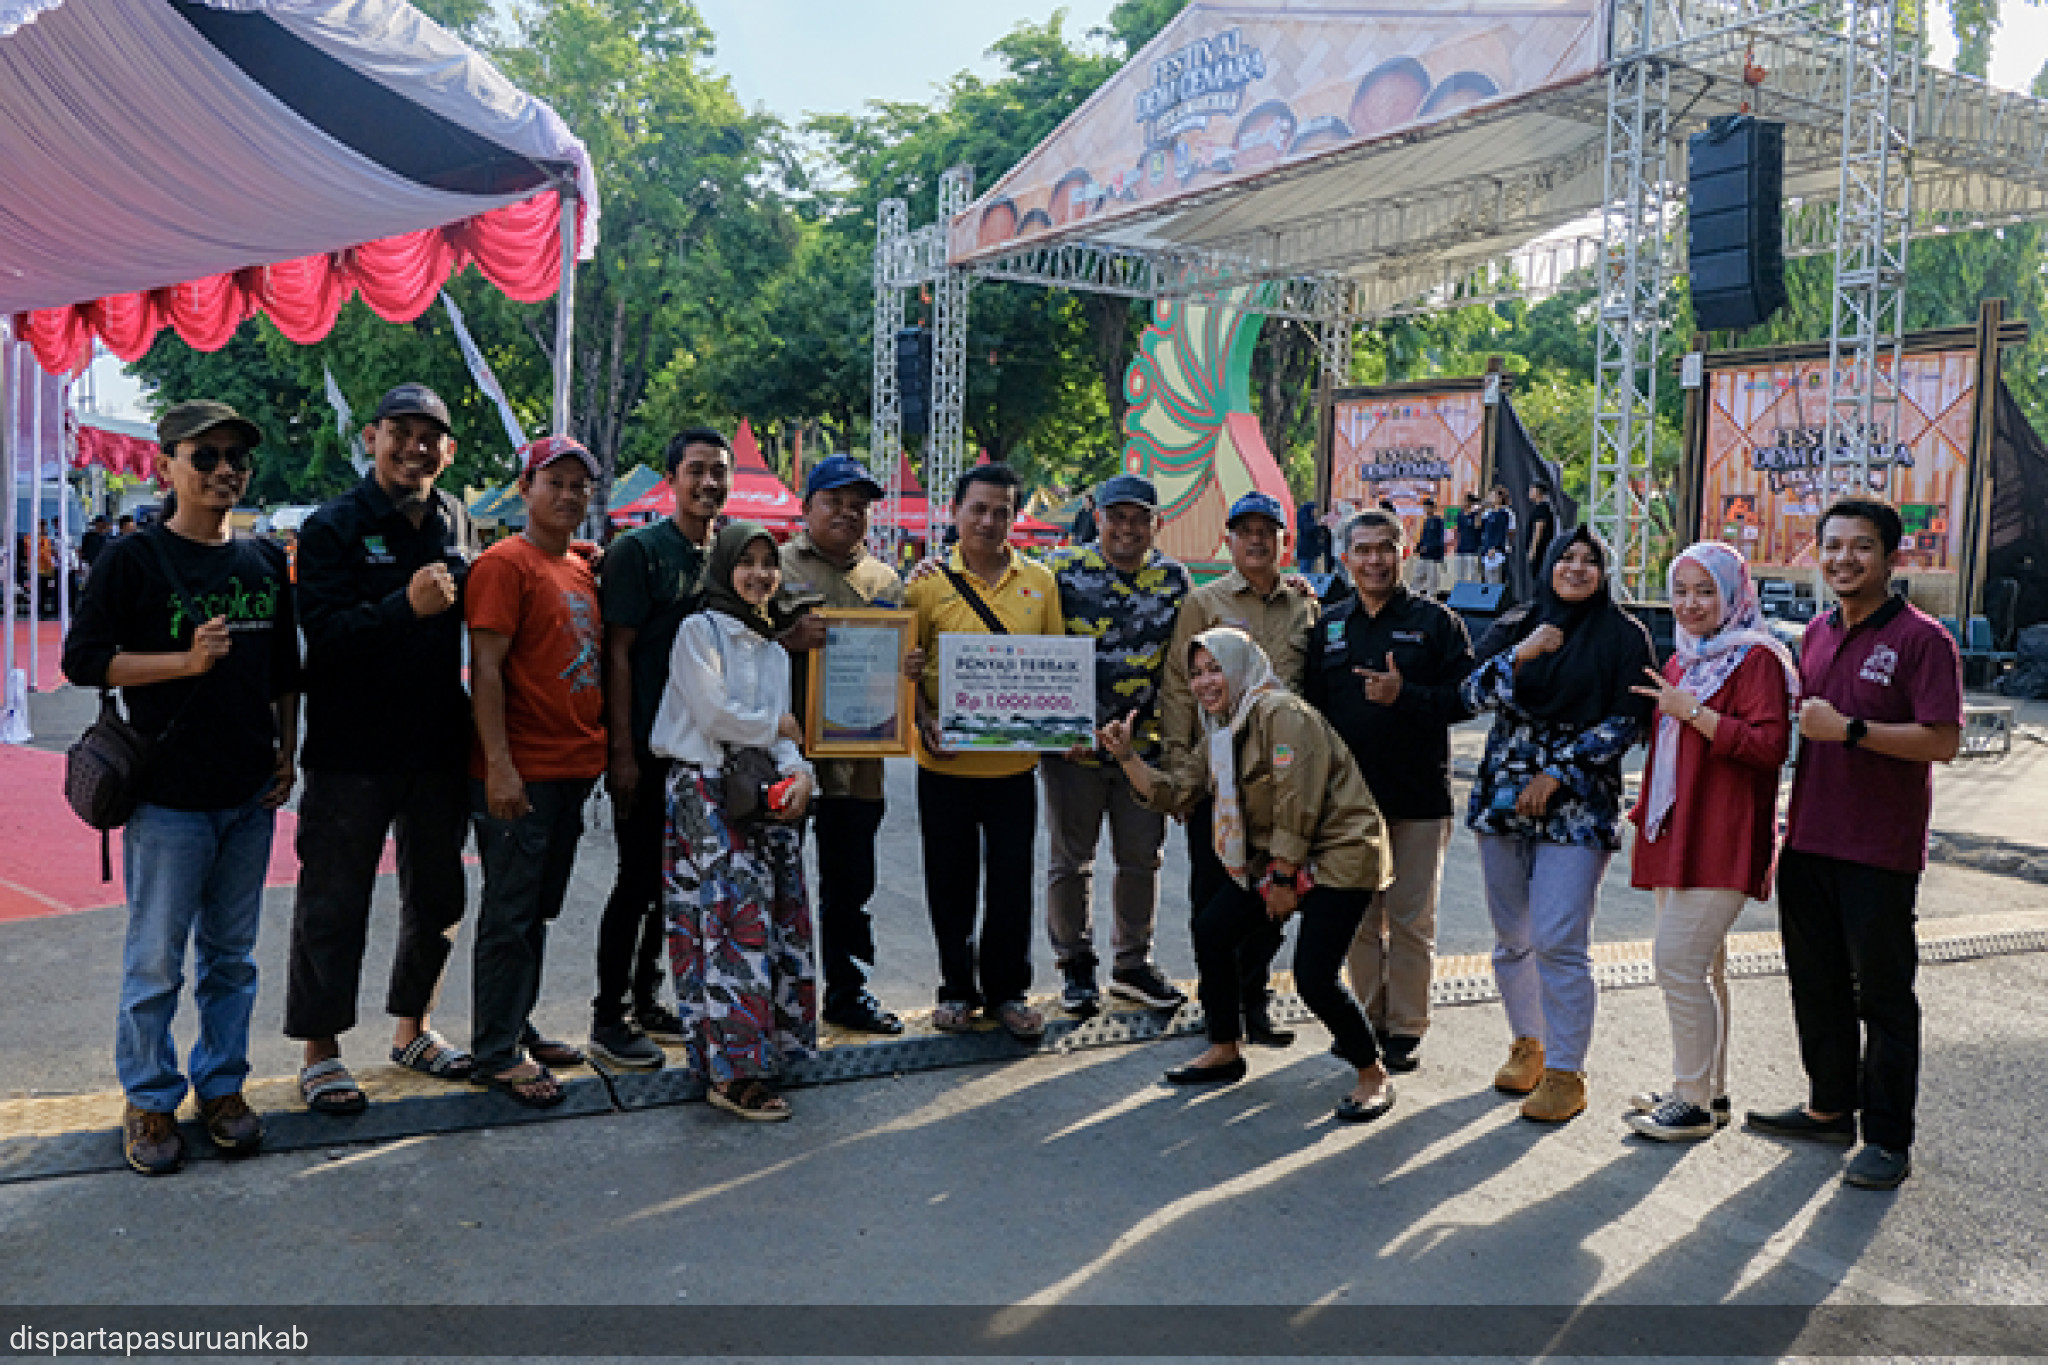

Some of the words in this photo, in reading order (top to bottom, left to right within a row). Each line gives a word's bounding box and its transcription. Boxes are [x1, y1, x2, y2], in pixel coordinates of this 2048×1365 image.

[955, 658, 1017, 673] PENYAJI
[1020, 658, 1079, 671] TERBAIK
[955, 692, 982, 711] Rp
